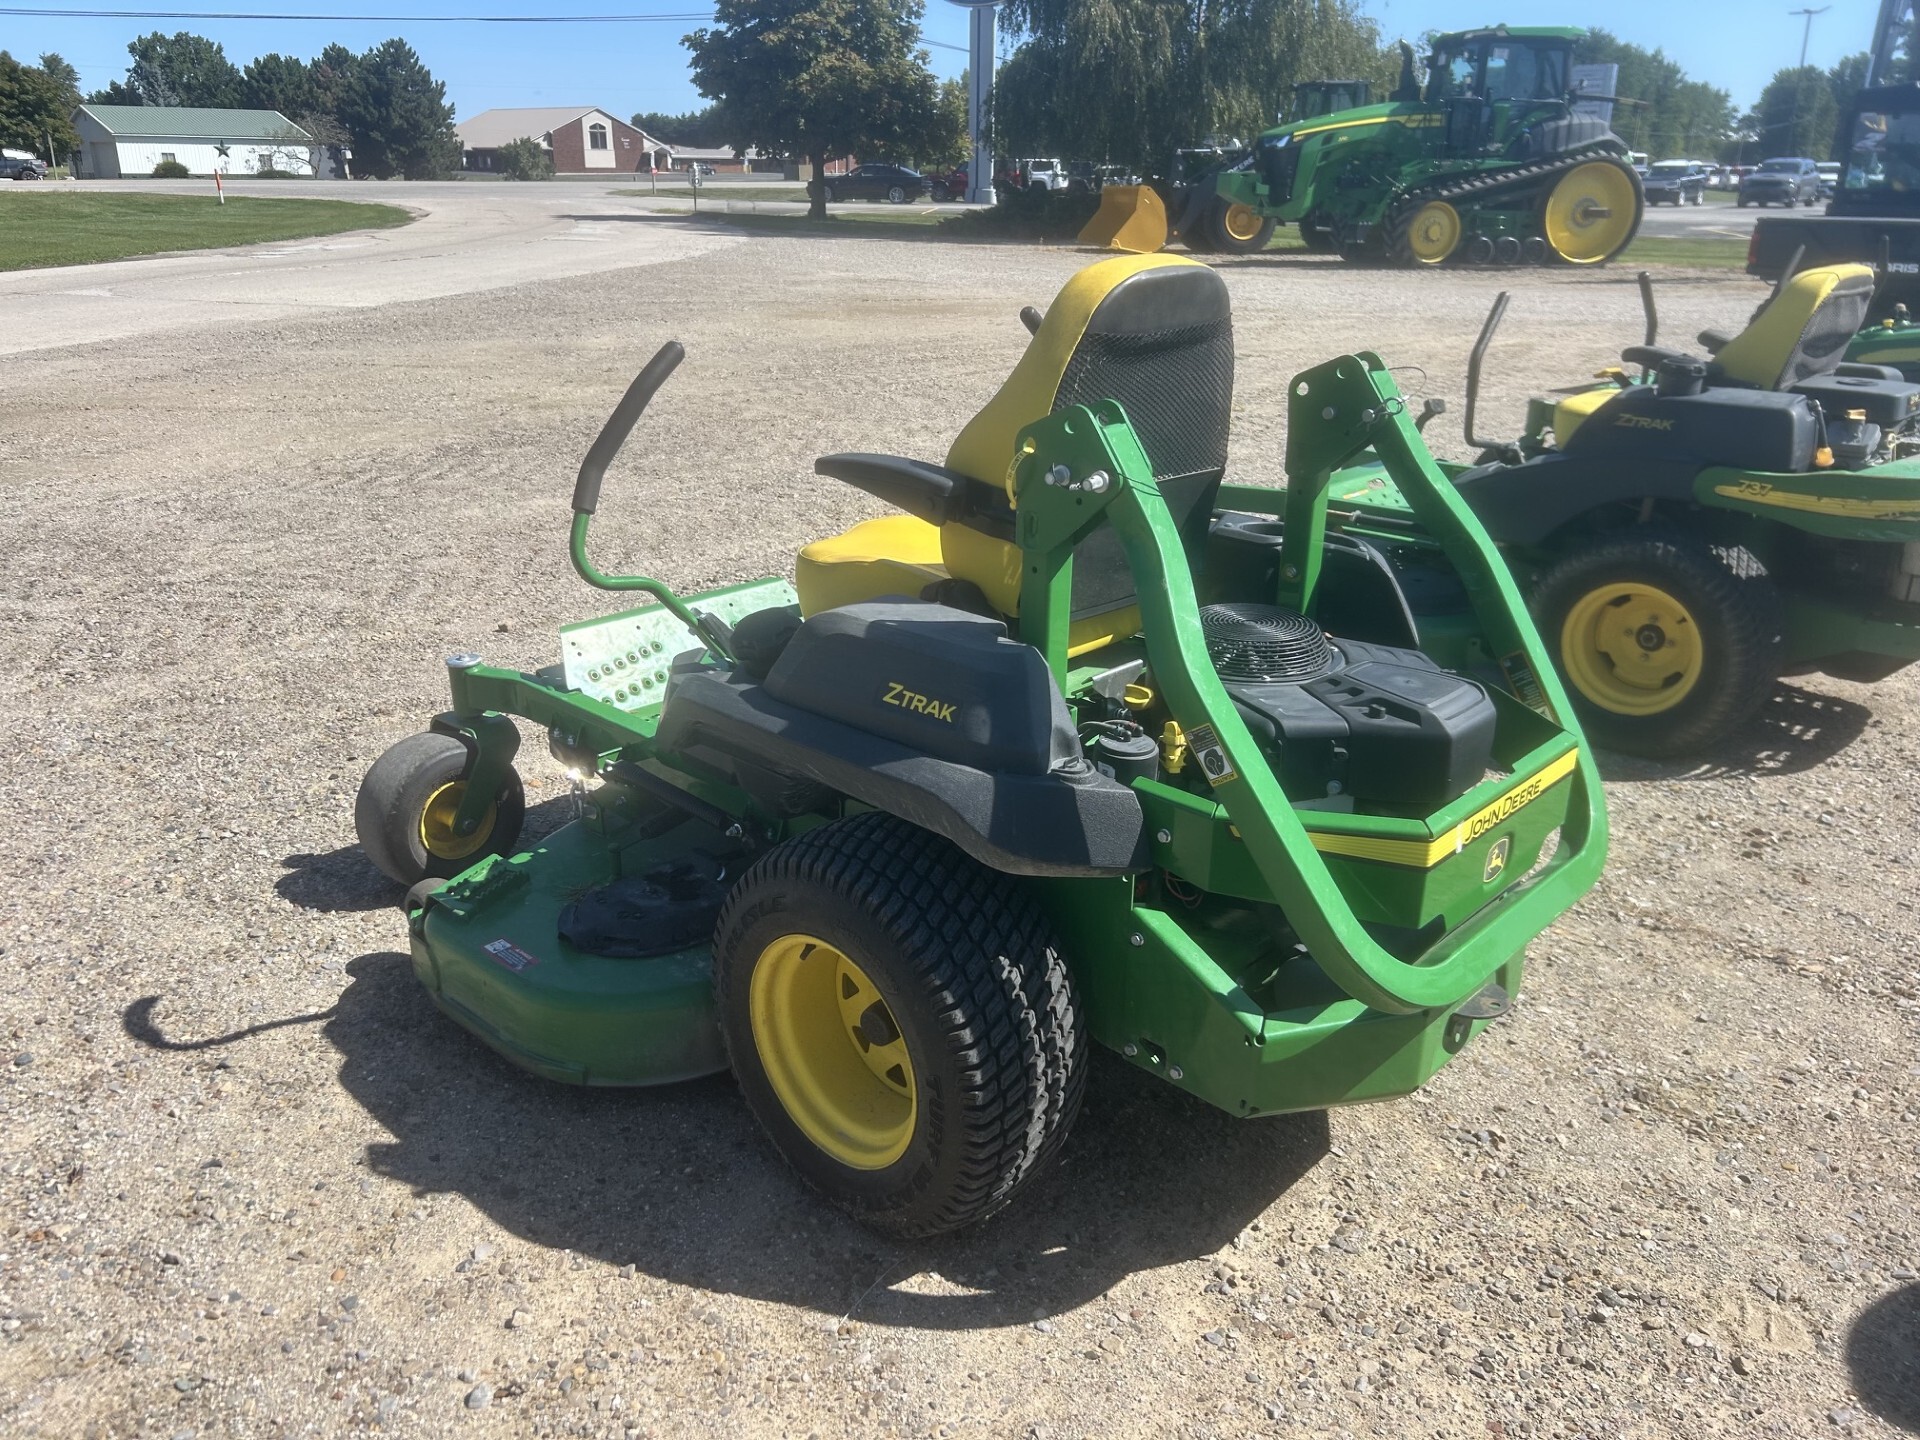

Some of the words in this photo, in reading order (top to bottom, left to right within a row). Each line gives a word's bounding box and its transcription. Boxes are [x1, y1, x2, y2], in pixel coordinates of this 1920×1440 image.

[1614, 413, 1676, 431] ZTRAK
[1738, 479, 1773, 496] 737
[882, 682, 957, 723] ZTRAK
[1464, 805, 1501, 842] JOHN
[1502, 778, 1542, 817] DEERE
